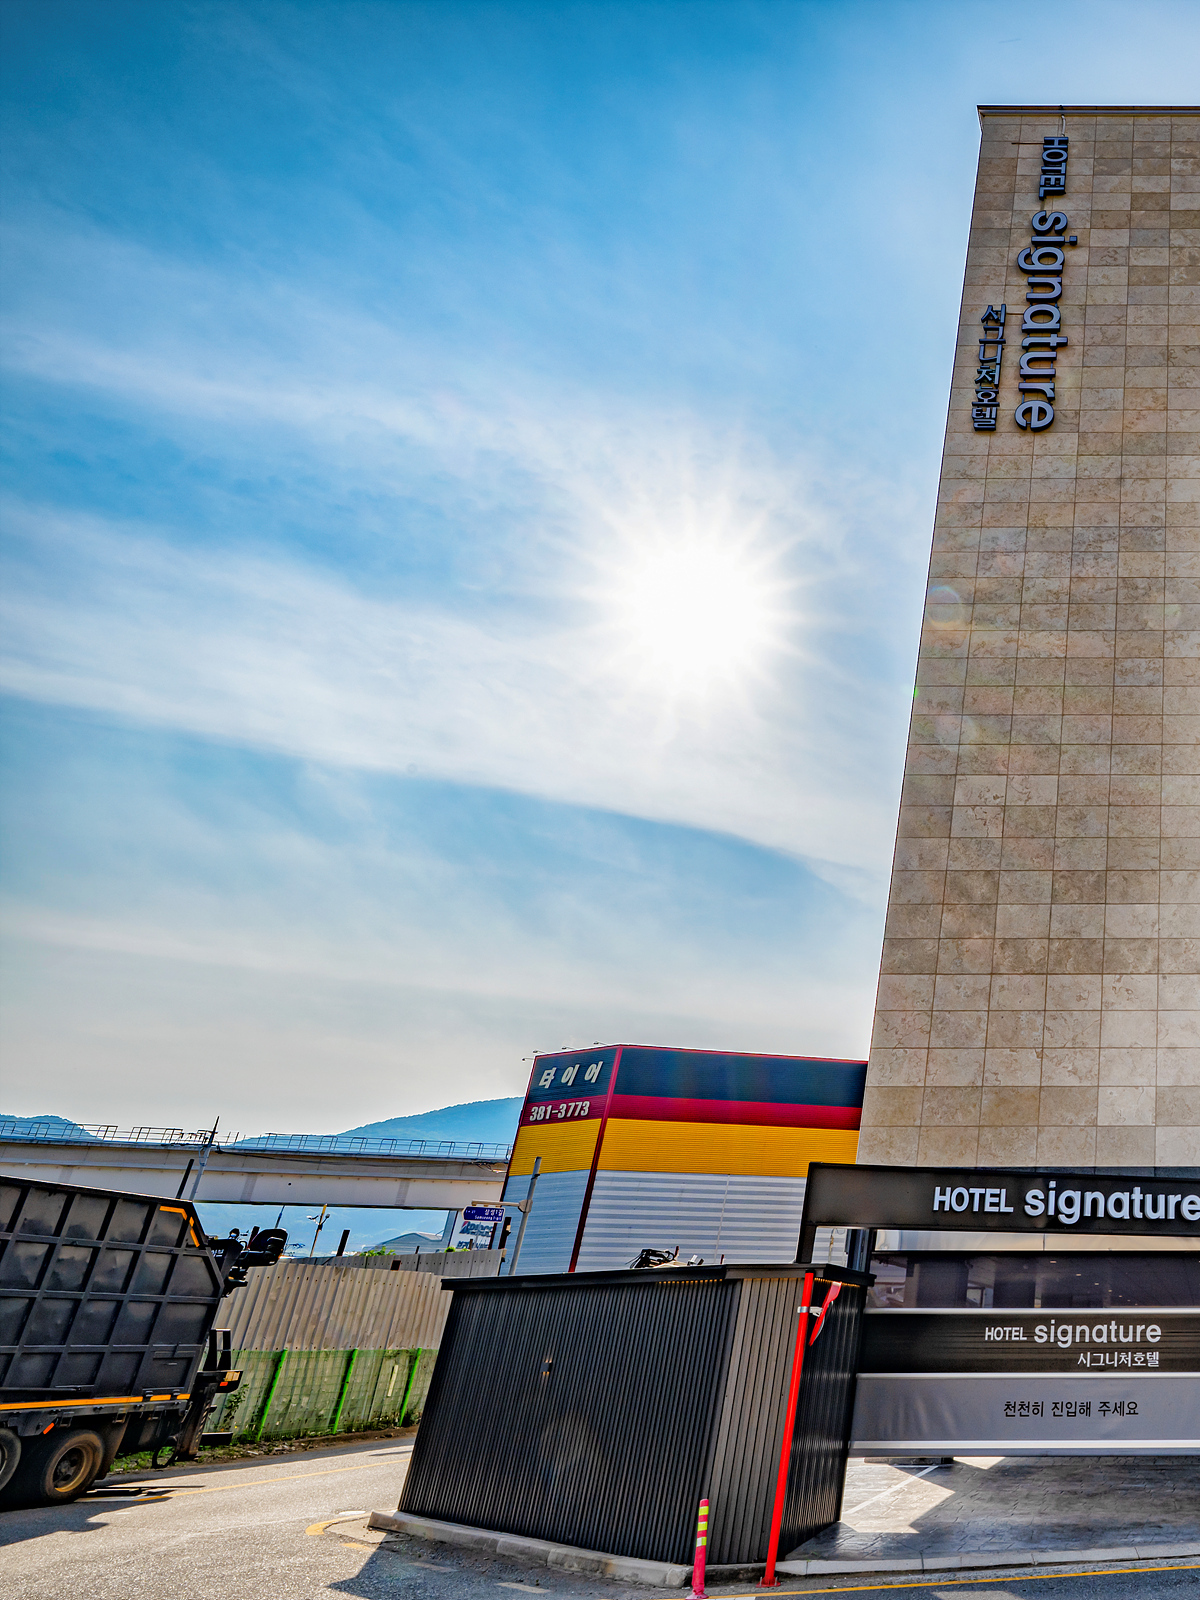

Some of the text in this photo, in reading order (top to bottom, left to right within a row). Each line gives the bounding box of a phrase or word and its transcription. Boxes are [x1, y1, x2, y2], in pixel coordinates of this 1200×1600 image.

[1014, 136, 1078, 432] HOTEL signature
[971, 303, 1007, 431] 시그니처호텔
[529, 1101, 590, 1122] 381-3773
[933, 1186, 1014, 1213] HOTEL
[984, 1319, 1162, 1348] HOTEL signature
[1077, 1352, 1160, 1368] 시그니처호텔
[1003, 1401, 1139, 1418] 천천히 진입해 주세요
